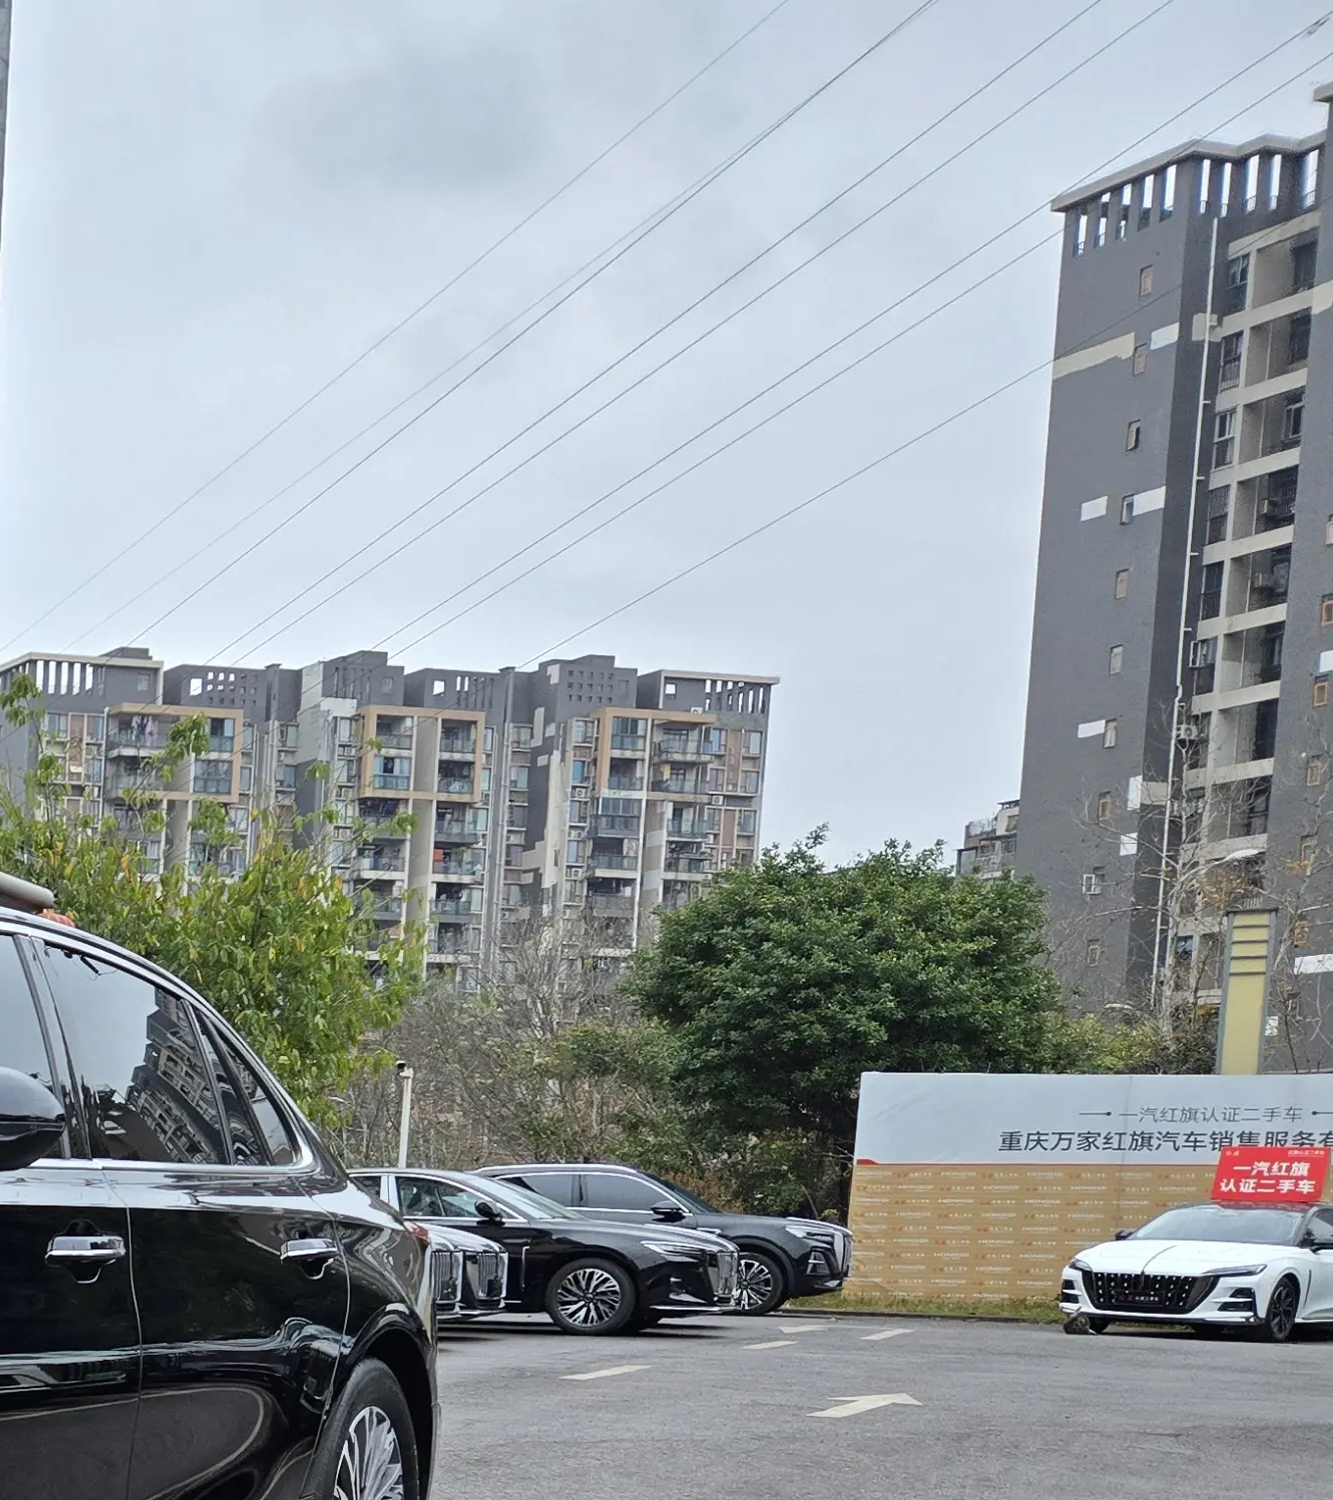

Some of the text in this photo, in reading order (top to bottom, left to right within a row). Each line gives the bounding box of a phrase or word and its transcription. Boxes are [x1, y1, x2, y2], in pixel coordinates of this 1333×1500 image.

[1119, 1106, 1303, 1122] 一汽红旗认证二手车
[1233, 1161, 1310, 1177] 一汽红旗
[1220, 1178, 1316, 1194] 认证二手车
